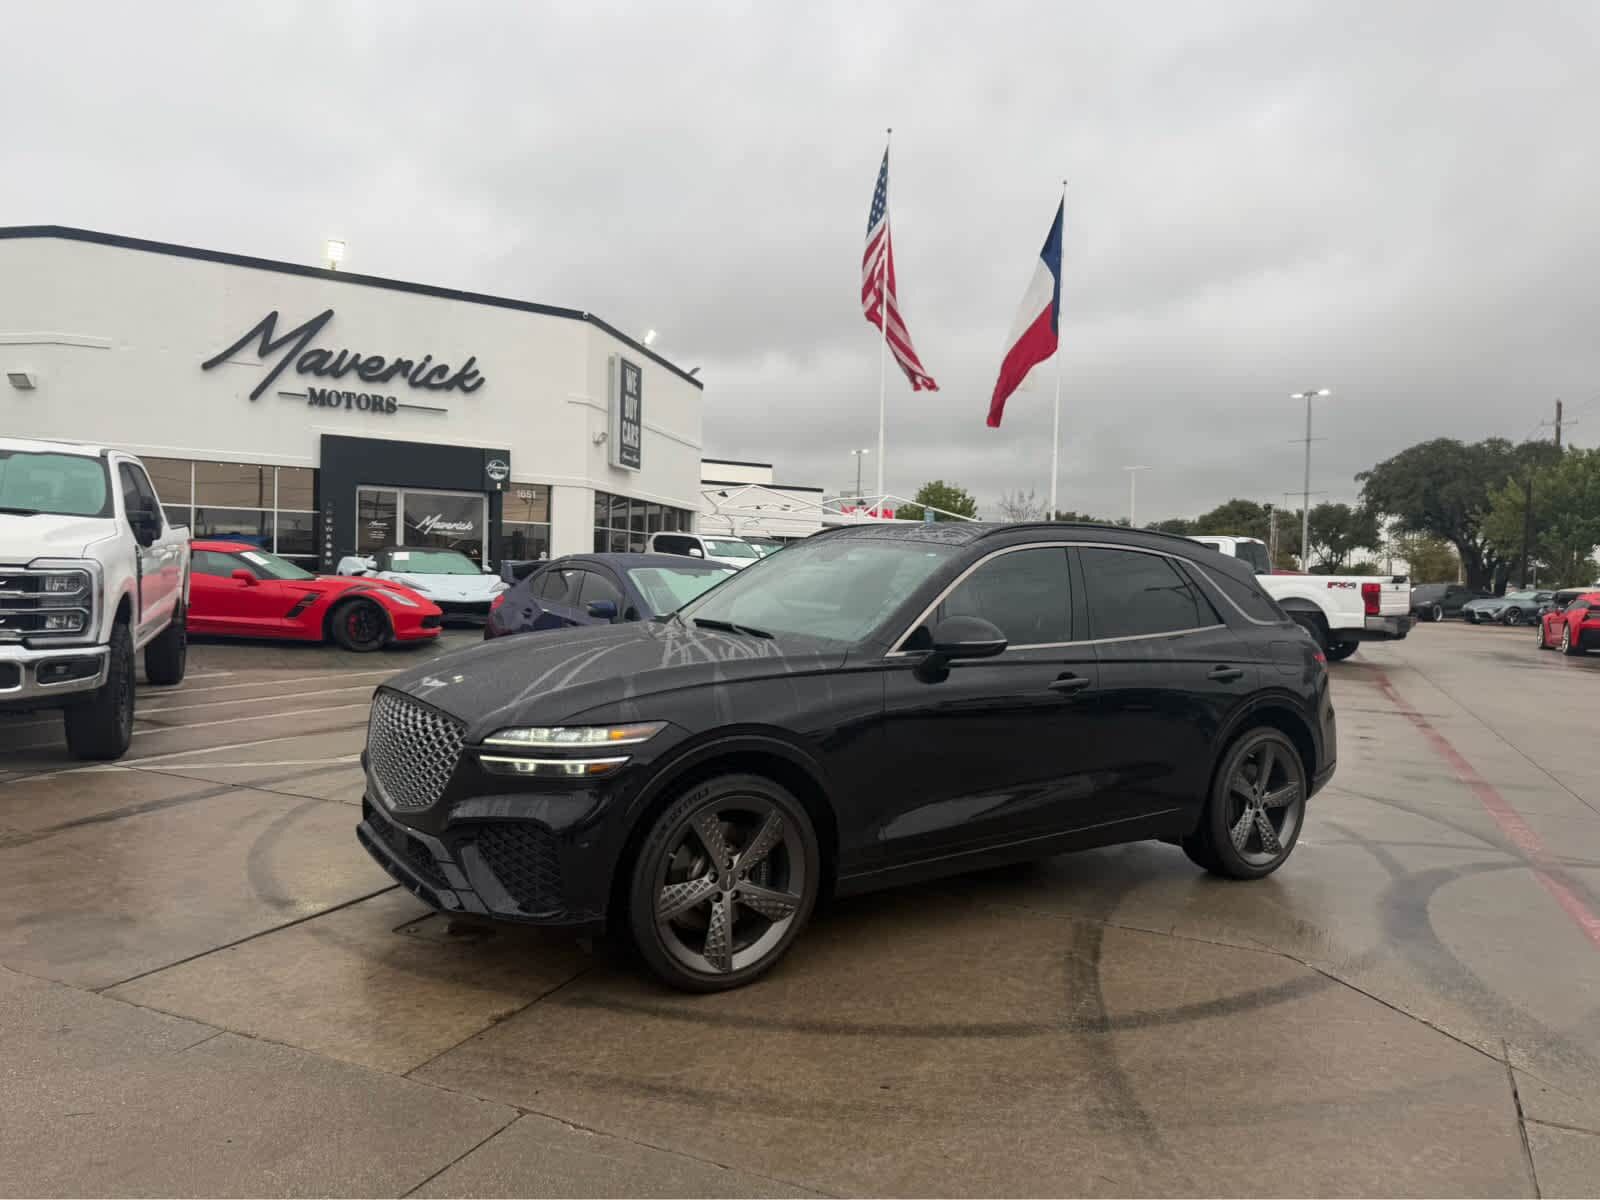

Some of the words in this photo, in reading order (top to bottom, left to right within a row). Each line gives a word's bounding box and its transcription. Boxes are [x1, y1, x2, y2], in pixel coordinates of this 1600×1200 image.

[201, 308, 486, 402] Maverick
[625, 367, 638, 395] WE
[307, 387, 399, 414] MOTORS
[622, 420, 639, 448] CARS
[516, 489, 536, 499] 1651
[1327, 582, 1357, 590] FX4
